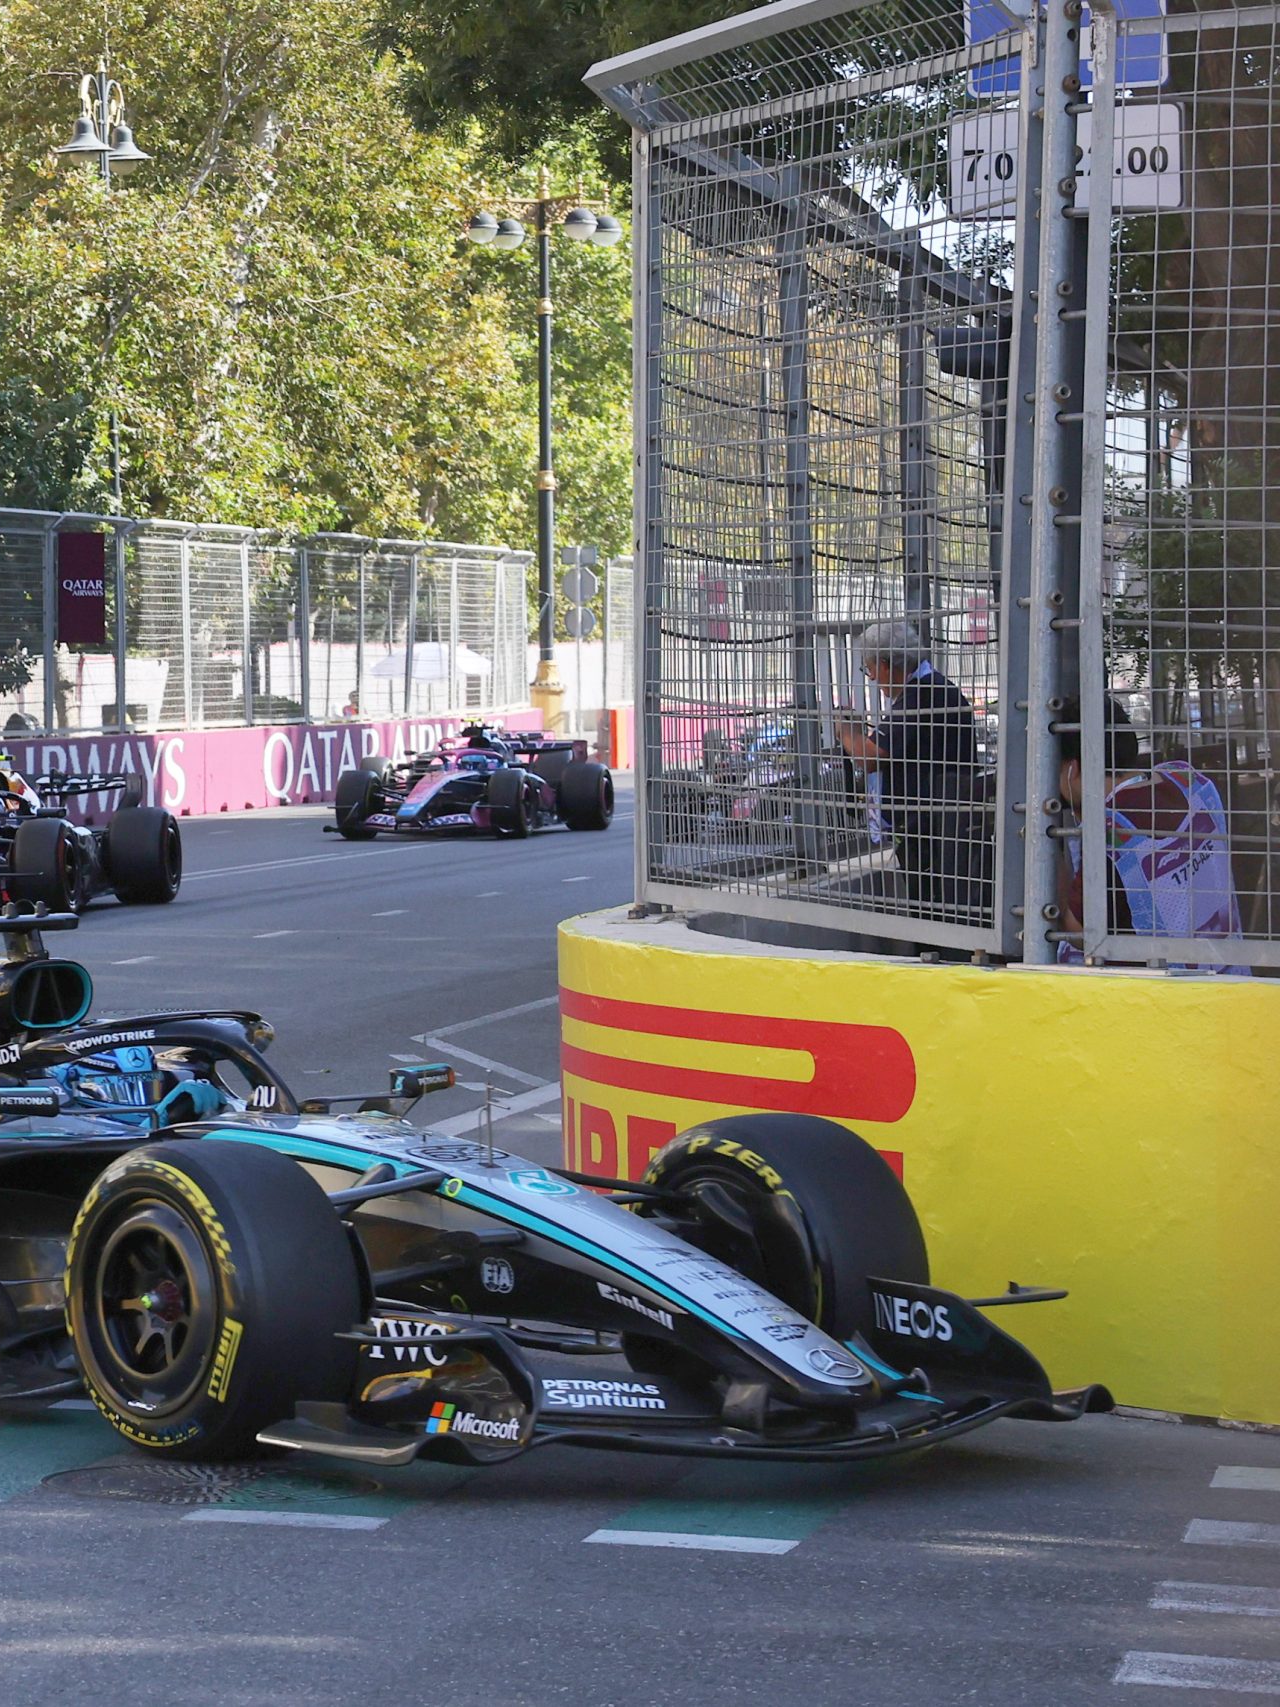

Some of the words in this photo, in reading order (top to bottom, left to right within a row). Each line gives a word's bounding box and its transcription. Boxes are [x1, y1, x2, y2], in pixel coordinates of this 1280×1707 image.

[62, 579, 103, 591] QATAR
[71, 589, 103, 597] AIRWAYS
[263, 728, 380, 799] QATAR
[69, 1029, 156, 1051] CROWDSTRIKE
[0, 1096, 53, 1106] PETRONAS
[483, 1262, 513, 1288] FIA
[597, 1282, 675, 1331] Einhell
[872, 1291, 953, 1341] INEOS
[368, 1317, 448, 1366] IWC
[542, 1379, 661, 1395] PETRONAS
[547, 1389, 667, 1410] Syntium
[452, 1411, 520, 1441] Microsoft
